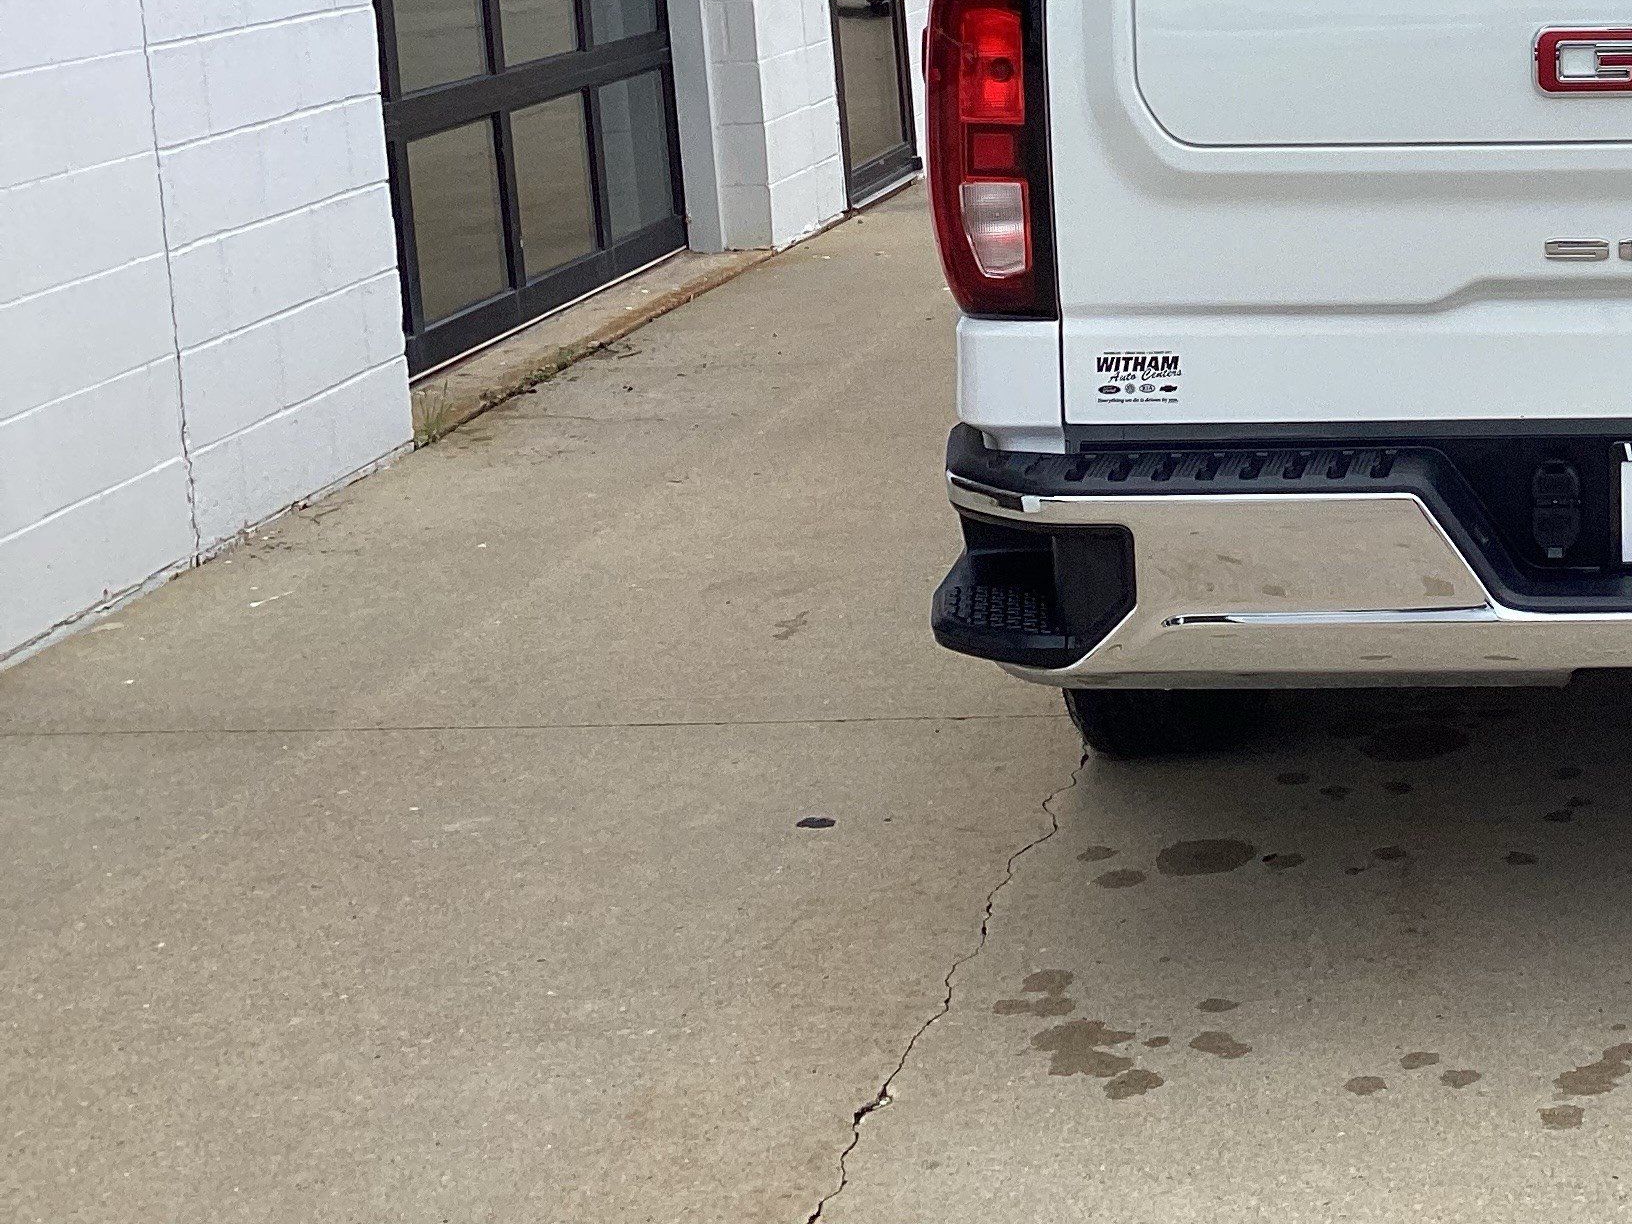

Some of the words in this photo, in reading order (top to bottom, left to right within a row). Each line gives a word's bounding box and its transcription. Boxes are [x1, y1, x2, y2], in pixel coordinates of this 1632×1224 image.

[1096, 355, 1180, 373] WITHAM
[1108, 370, 1137, 383] Auto
[1141, 367, 1182, 381] Centers
